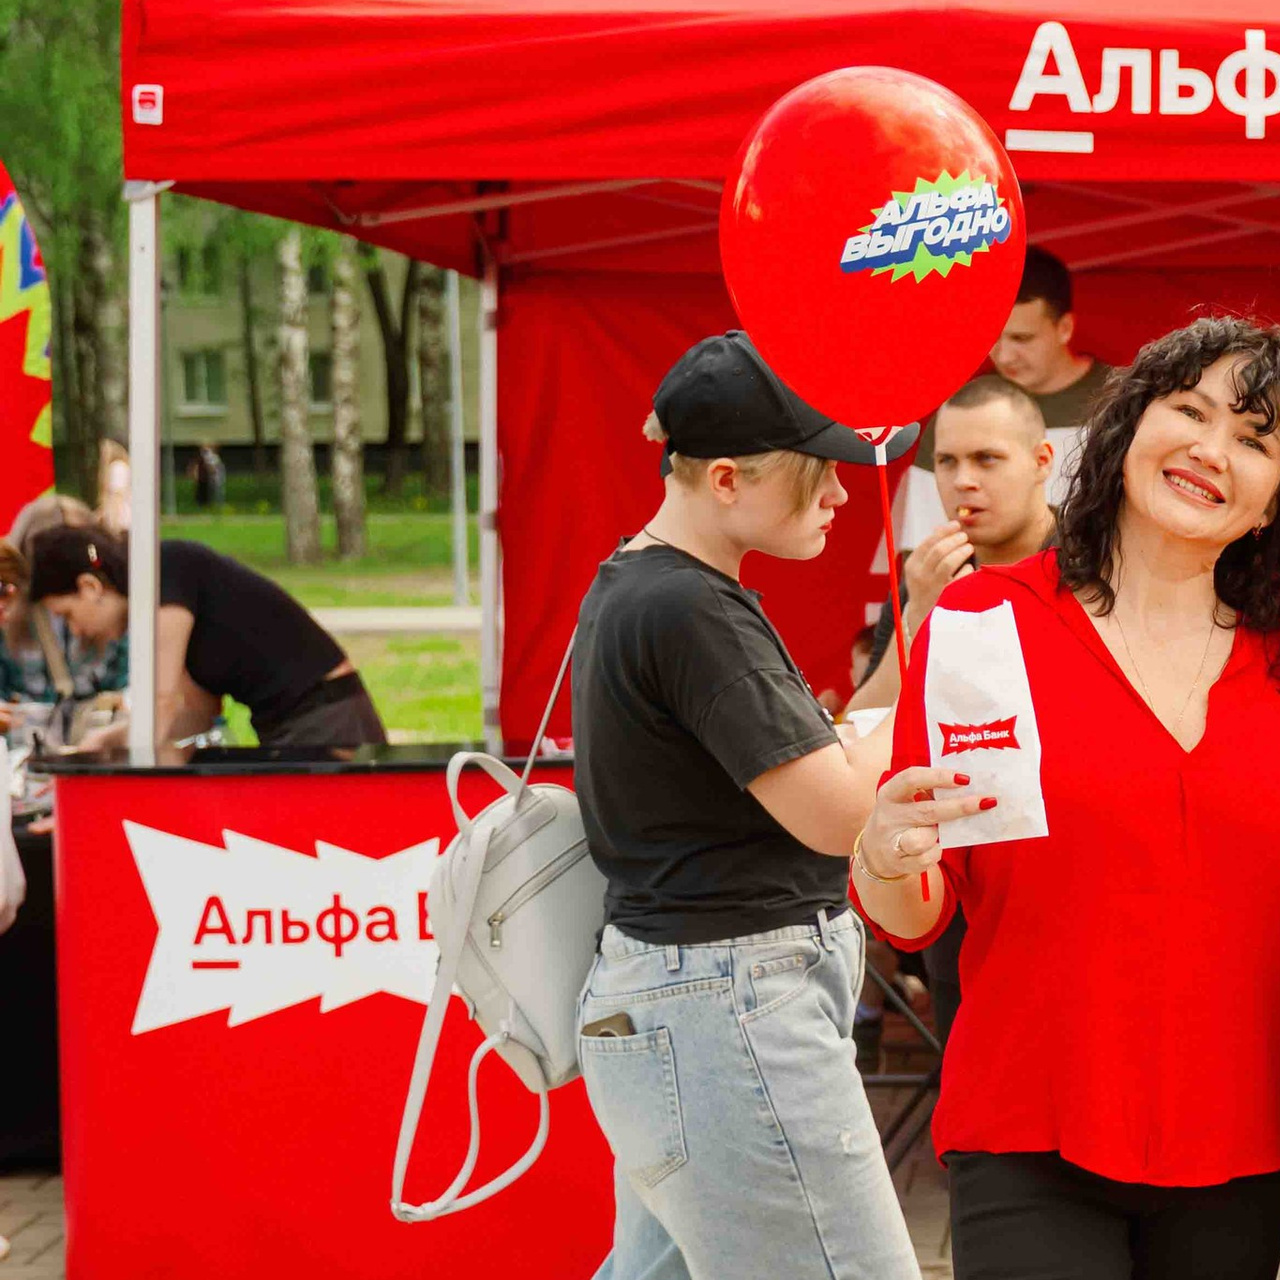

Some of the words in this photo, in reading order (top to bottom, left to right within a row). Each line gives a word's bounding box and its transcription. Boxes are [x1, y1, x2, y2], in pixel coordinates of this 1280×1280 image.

[871, 182, 996, 229] АЛЬФА
[840, 206, 1009, 264] ВЫГОДНО
[949, 732, 982, 747] Альфа
[983, 729, 1010, 741] Банк
[192, 892, 399, 969] Альфа
